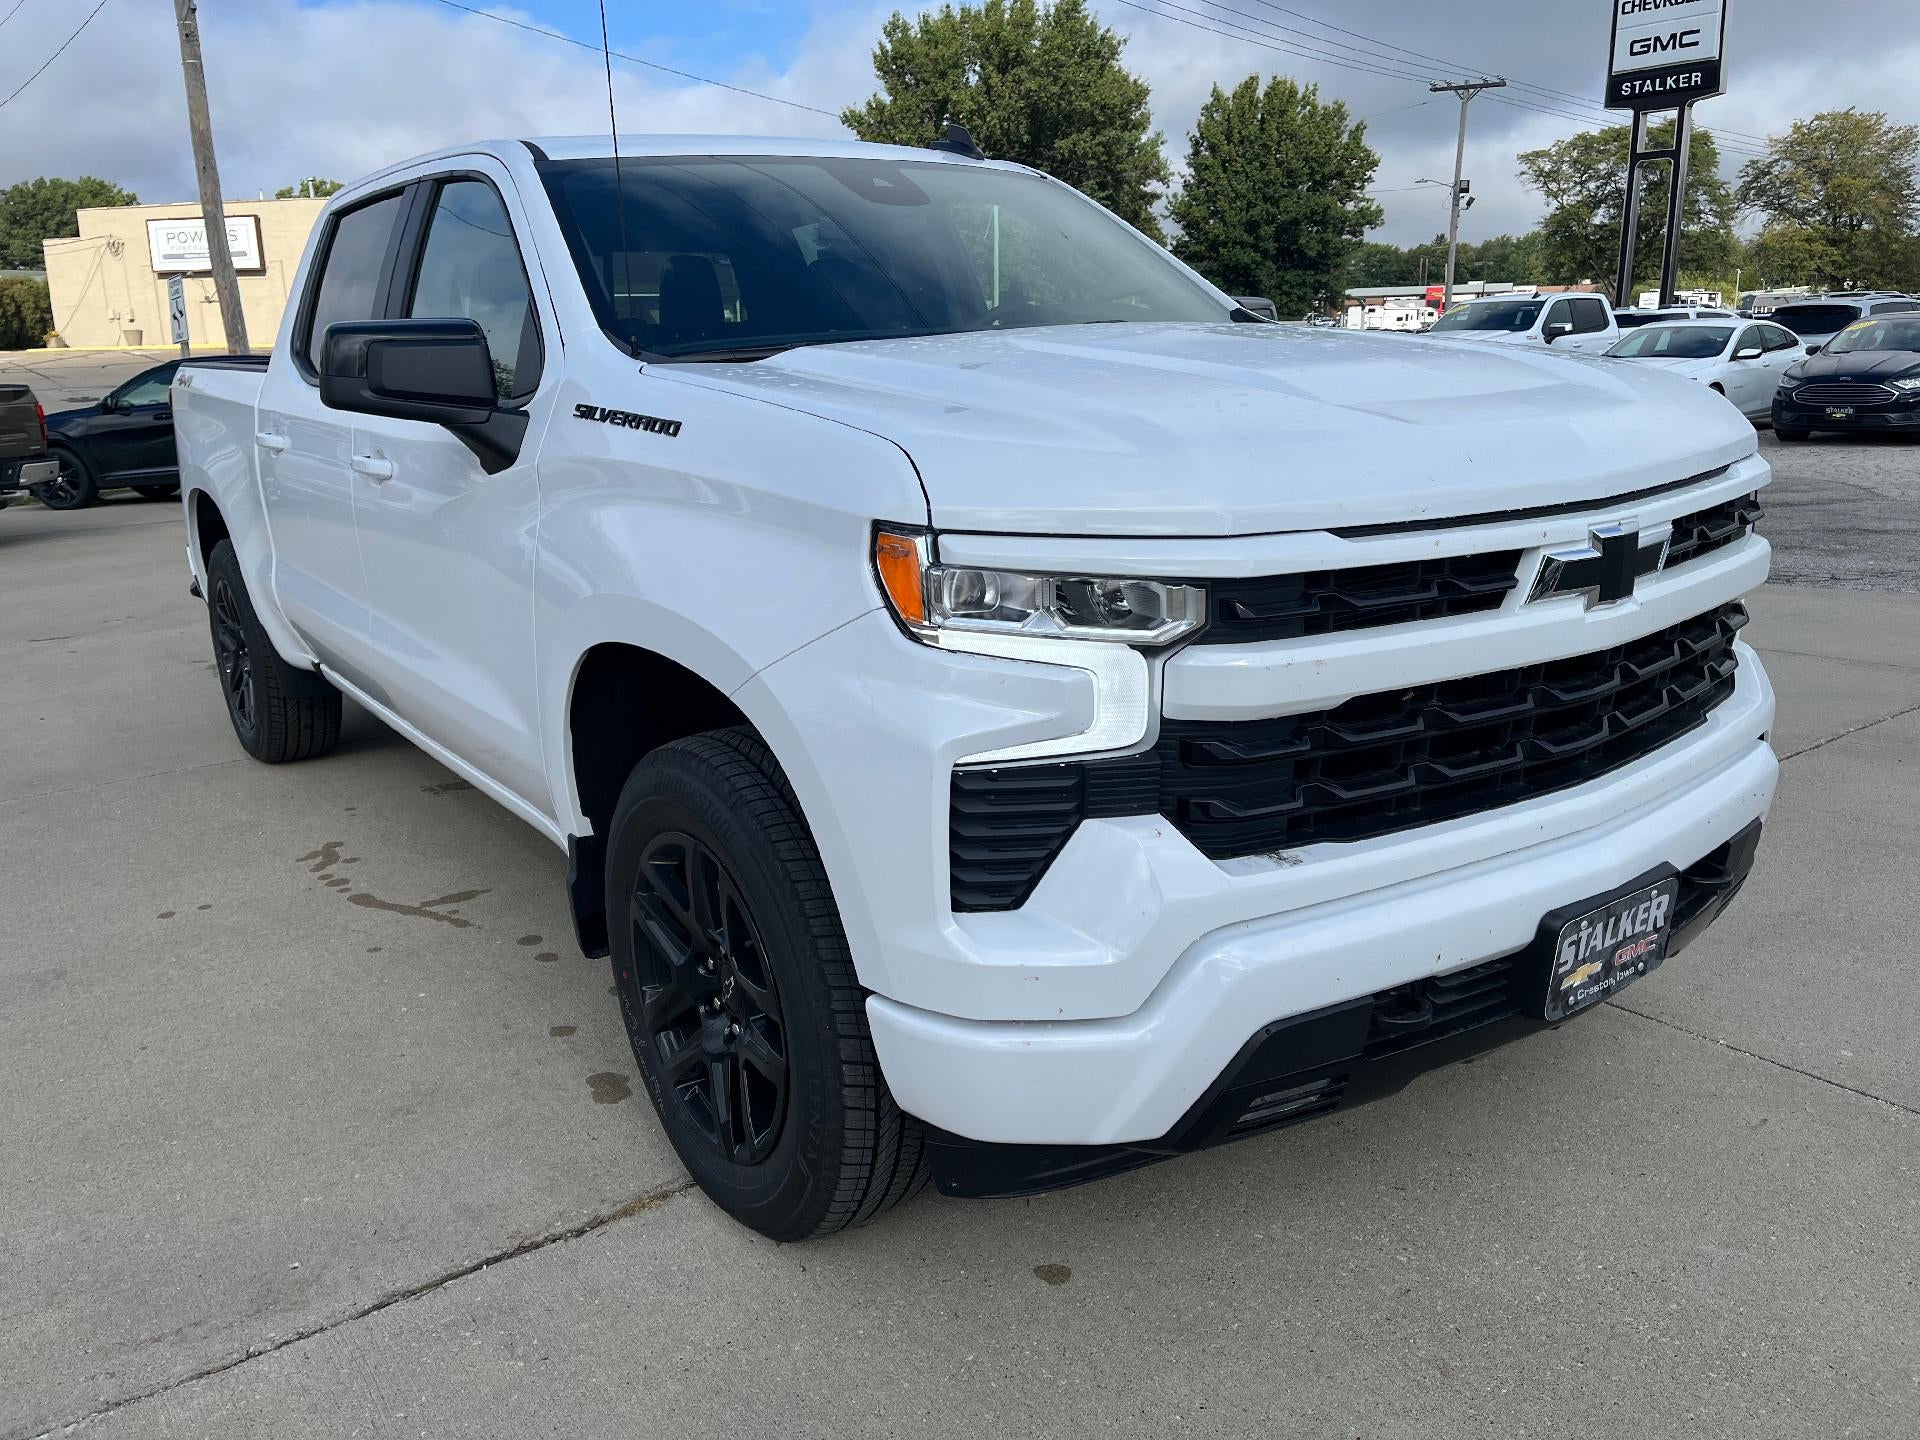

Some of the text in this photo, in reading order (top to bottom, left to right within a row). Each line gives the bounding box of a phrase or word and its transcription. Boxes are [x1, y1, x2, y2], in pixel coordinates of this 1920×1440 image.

[1621, 0, 1703, 15] CHEVR
[1629, 28, 1701, 57] GMC
[1621, 72, 1702, 96] STALKER
[166, 229, 238, 243] POWS
[572, 403, 683, 438] SILVERADO
[1558, 893, 1670, 976] STALKER
[1614, 933, 1659, 967] GMC
[1616, 966, 1636, 982] Iowa
